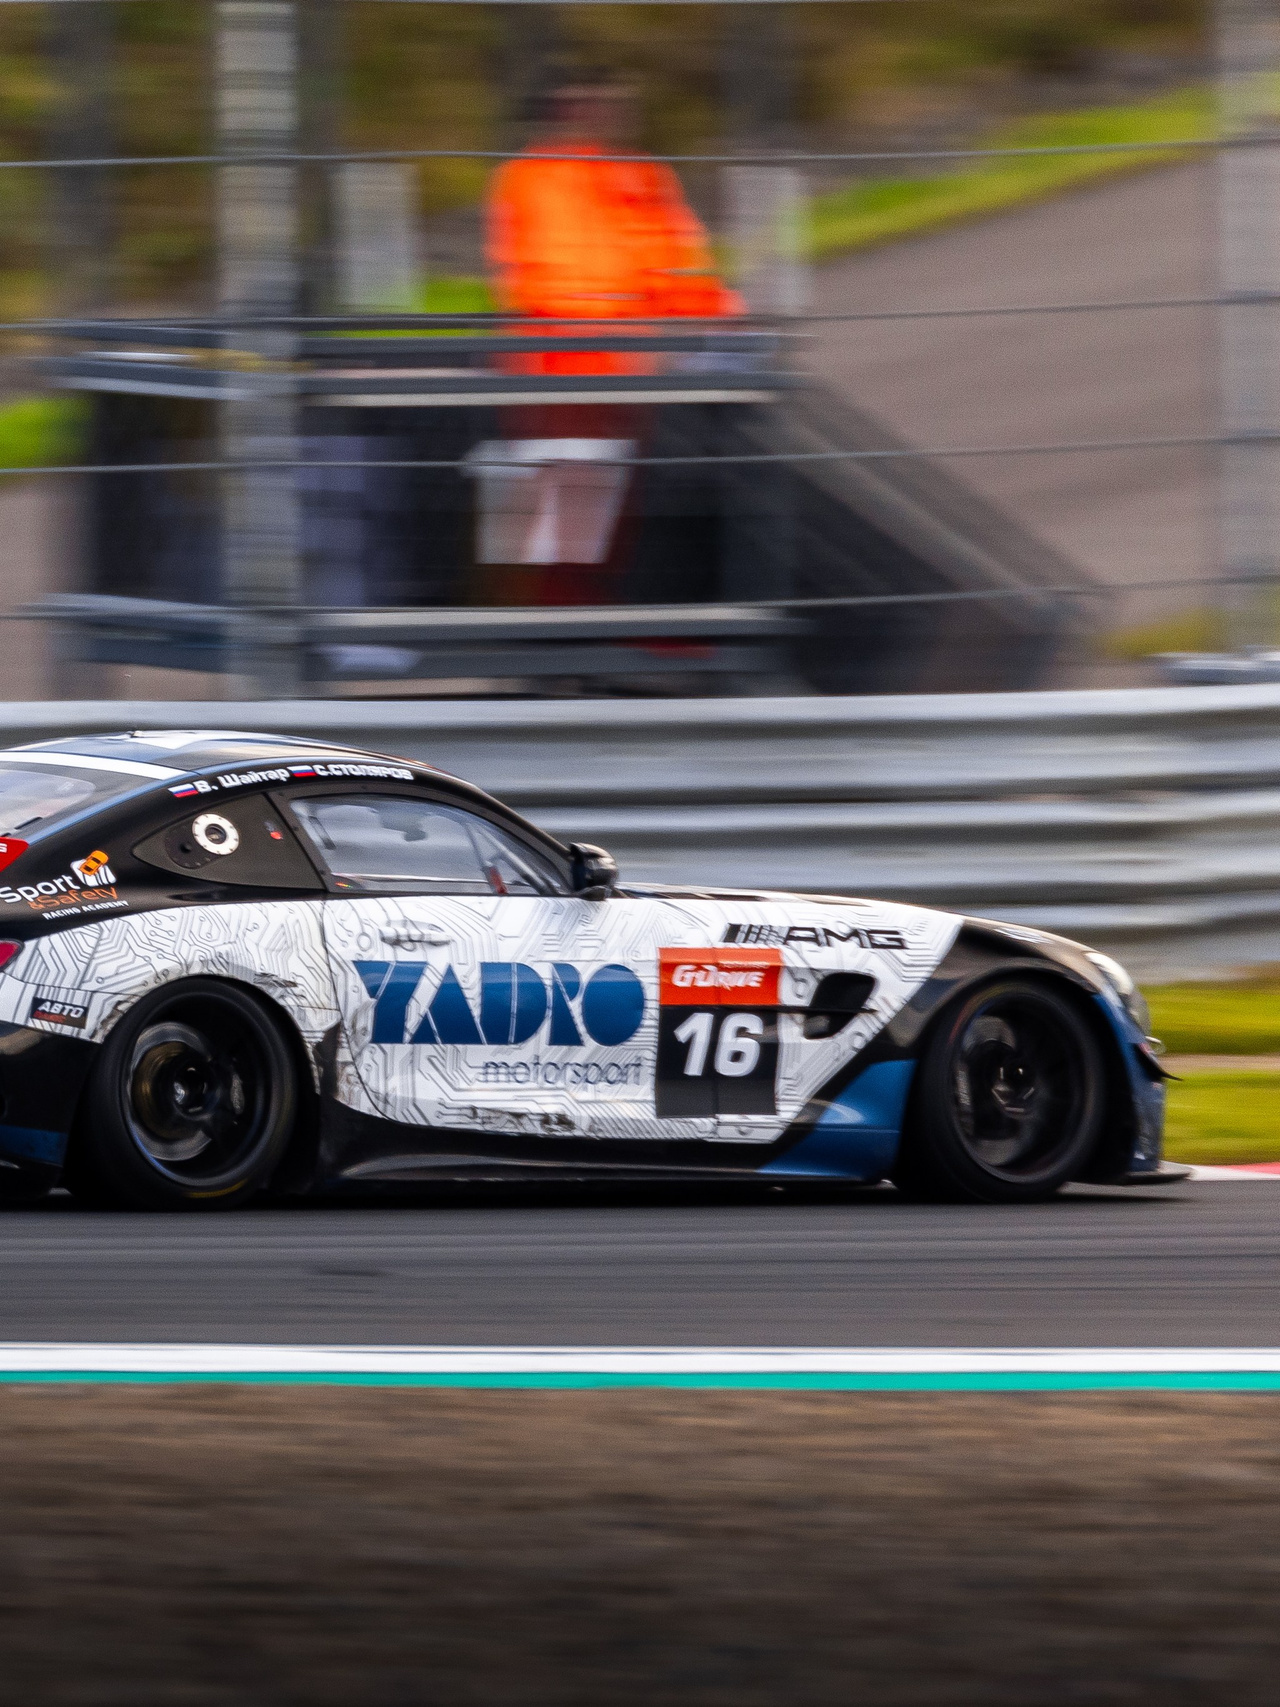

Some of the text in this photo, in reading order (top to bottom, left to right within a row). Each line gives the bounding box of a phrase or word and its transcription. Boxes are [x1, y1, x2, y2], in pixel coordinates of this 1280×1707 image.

[42, 900, 130, 920] RACING ACADEMY
[778, 924, 908, 949] AMG
[353, 960, 645, 1047] YADRO
[673, 1012, 764, 1078] 16
[483, 1054, 642, 1091] motorsport
